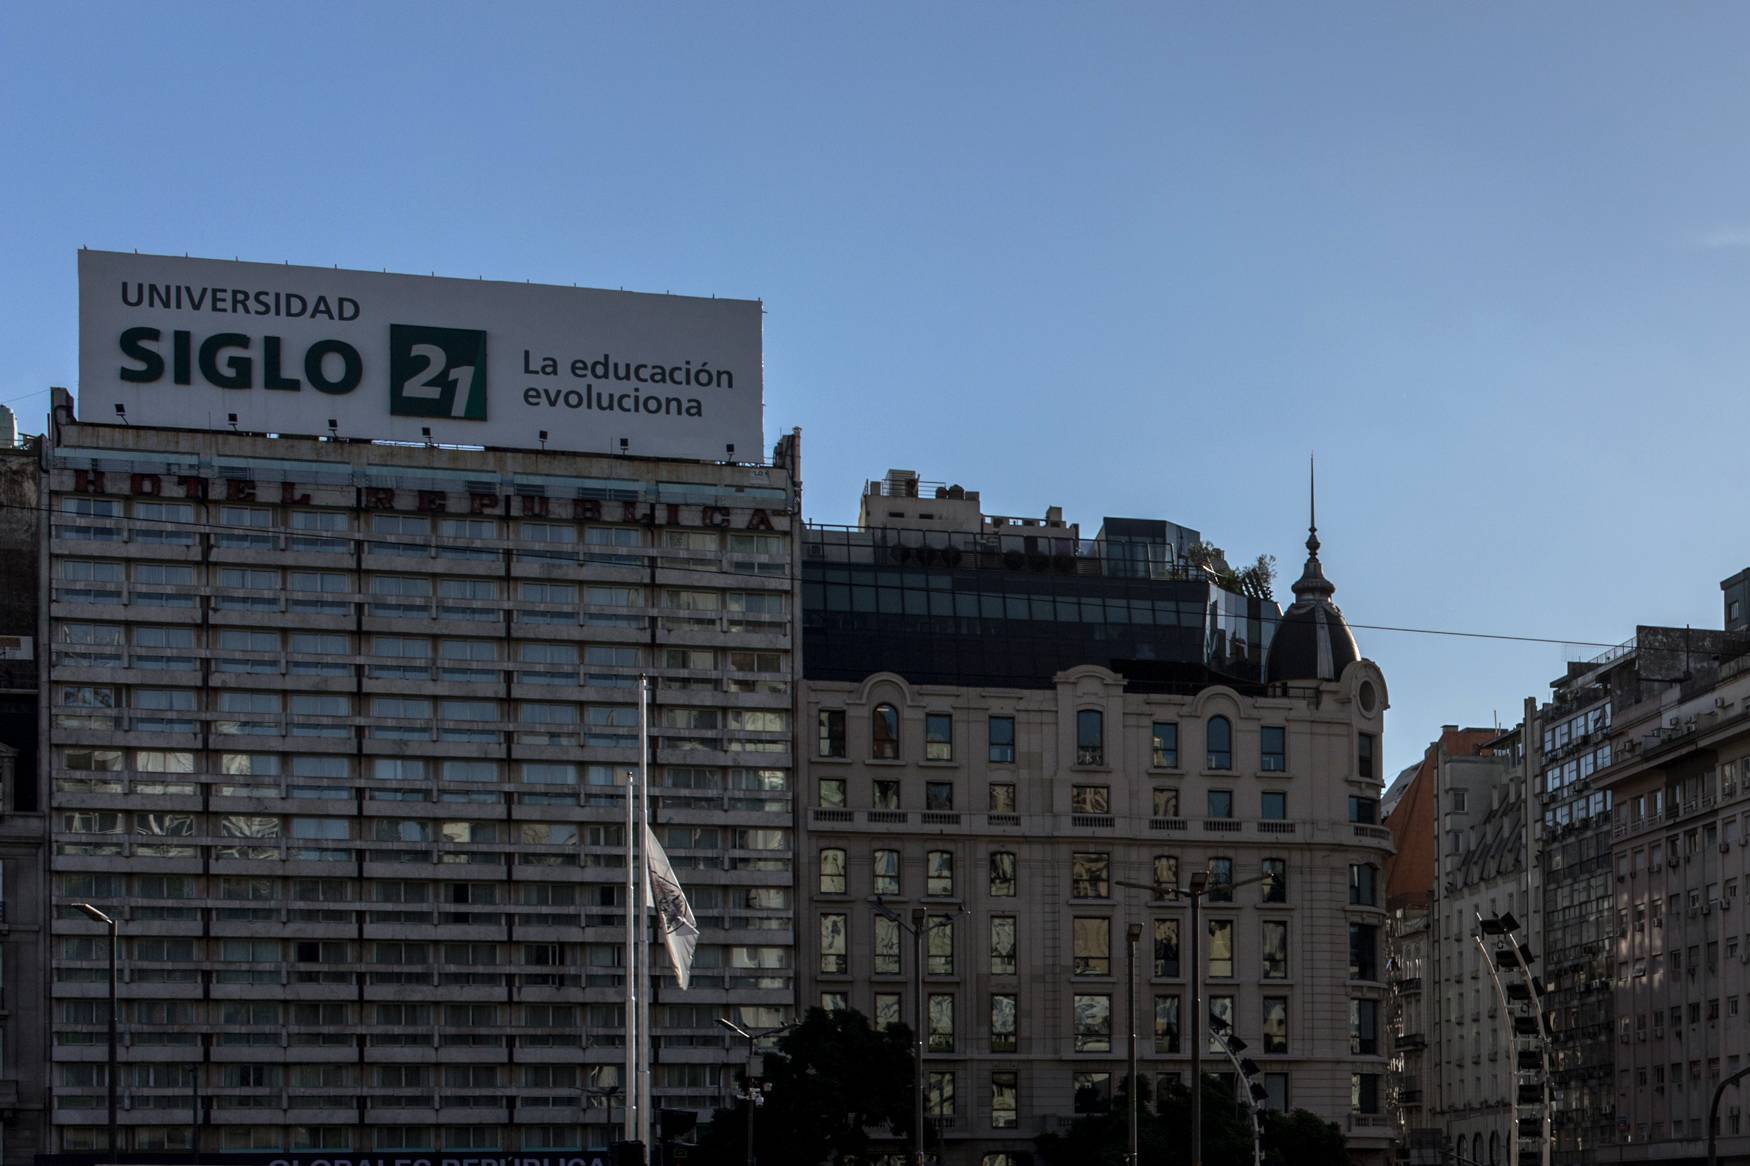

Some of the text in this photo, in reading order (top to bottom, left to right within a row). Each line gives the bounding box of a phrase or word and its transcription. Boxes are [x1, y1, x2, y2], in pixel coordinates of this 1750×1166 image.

[121, 281, 360, 321] UNIVERSIDAD
[119, 326, 476, 418] SIGLO 21
[523, 349, 734, 389] La educación
[523, 383, 703, 418] evoluciona
[74, 469, 312, 506] HOTEL
